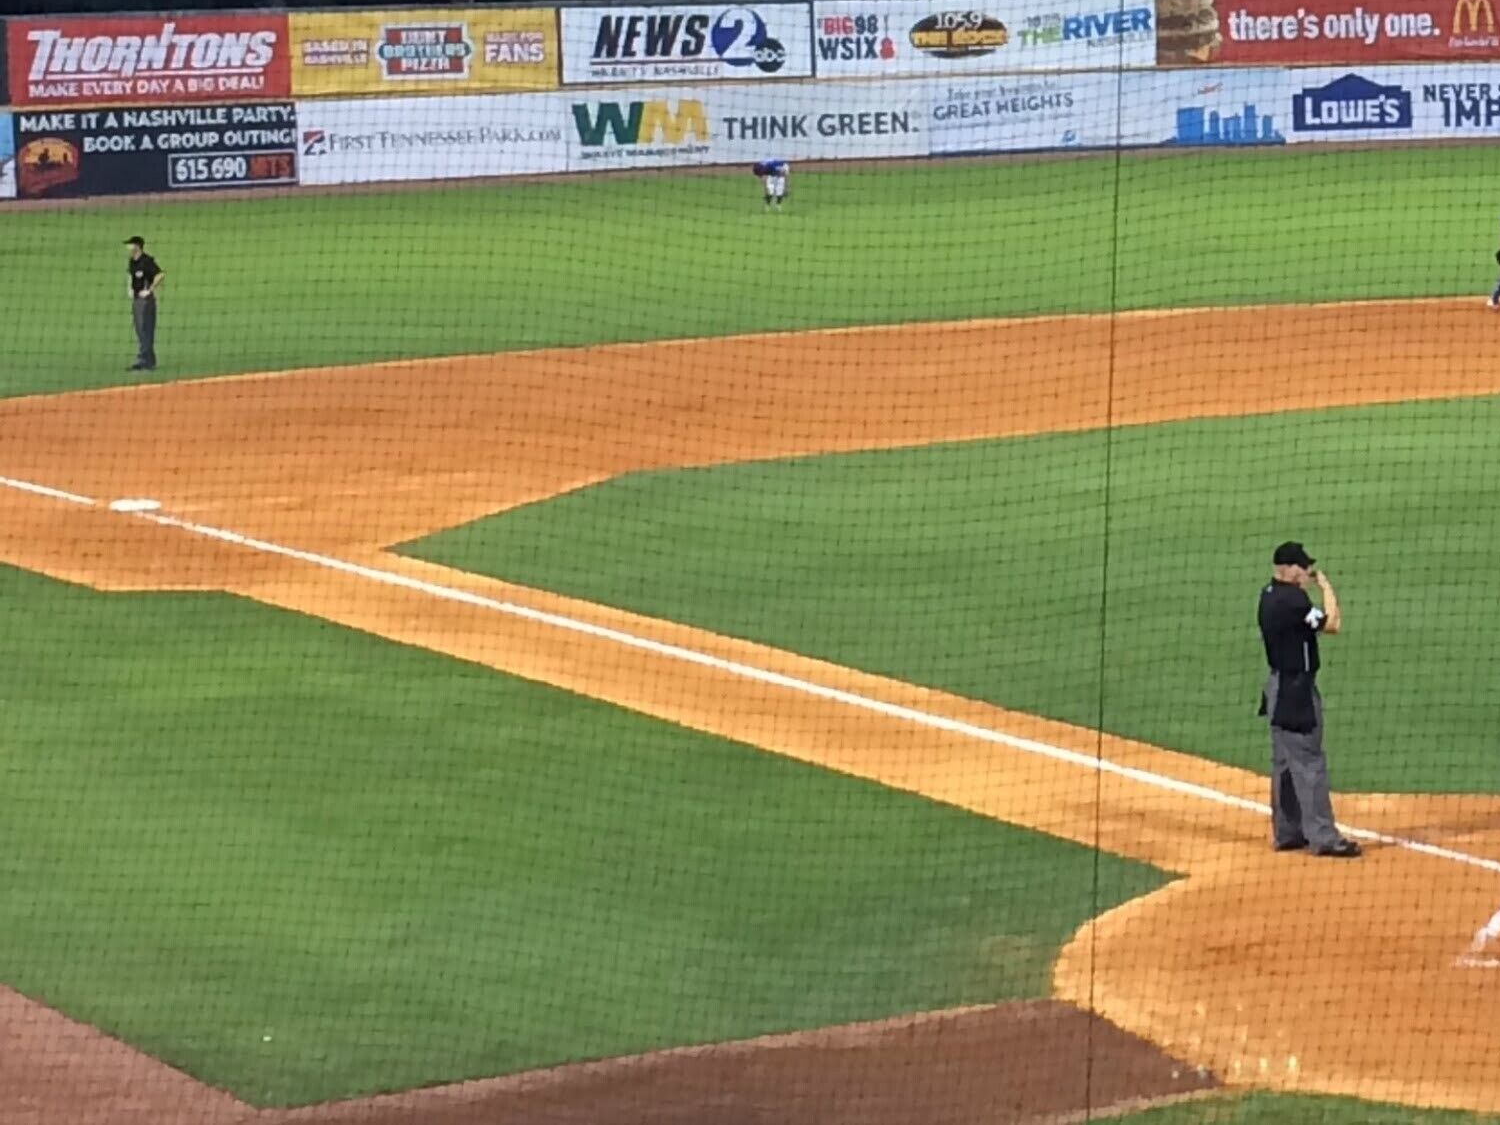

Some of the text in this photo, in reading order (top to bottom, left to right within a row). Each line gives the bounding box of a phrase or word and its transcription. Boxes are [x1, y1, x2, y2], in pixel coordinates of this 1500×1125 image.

[593, 9, 757, 59] NEWS 2
[1063, 7, 1152, 40] RIVER
[1228, 7, 1440, 44] there's only one.
[27, 22, 277, 81] THORNTONS
[485, 43, 544, 62] FANS
[818, 37, 878, 60] WSIX
[29, 83, 79, 98] MAKE
[83, 80, 133, 96] EVERY
[137, 78, 170, 94] DAY
[172, 78, 185, 93] A
[1423, 83, 1490, 103] NEVER
[20, 105, 296, 132] MAKE IT A NASHVILLE PARTY.
[934, 91, 1074, 121] GREAT HEIGHTS
[1304, 93, 1402, 125] LOWE'S
[572, 99, 709, 146] WM
[723, 110, 920, 140] THINK GREEN.
[83, 127, 297, 153] BOOK A GROUP OUTING!
[176, 158, 209, 181] 615
[211, 156, 247, 179] 690
